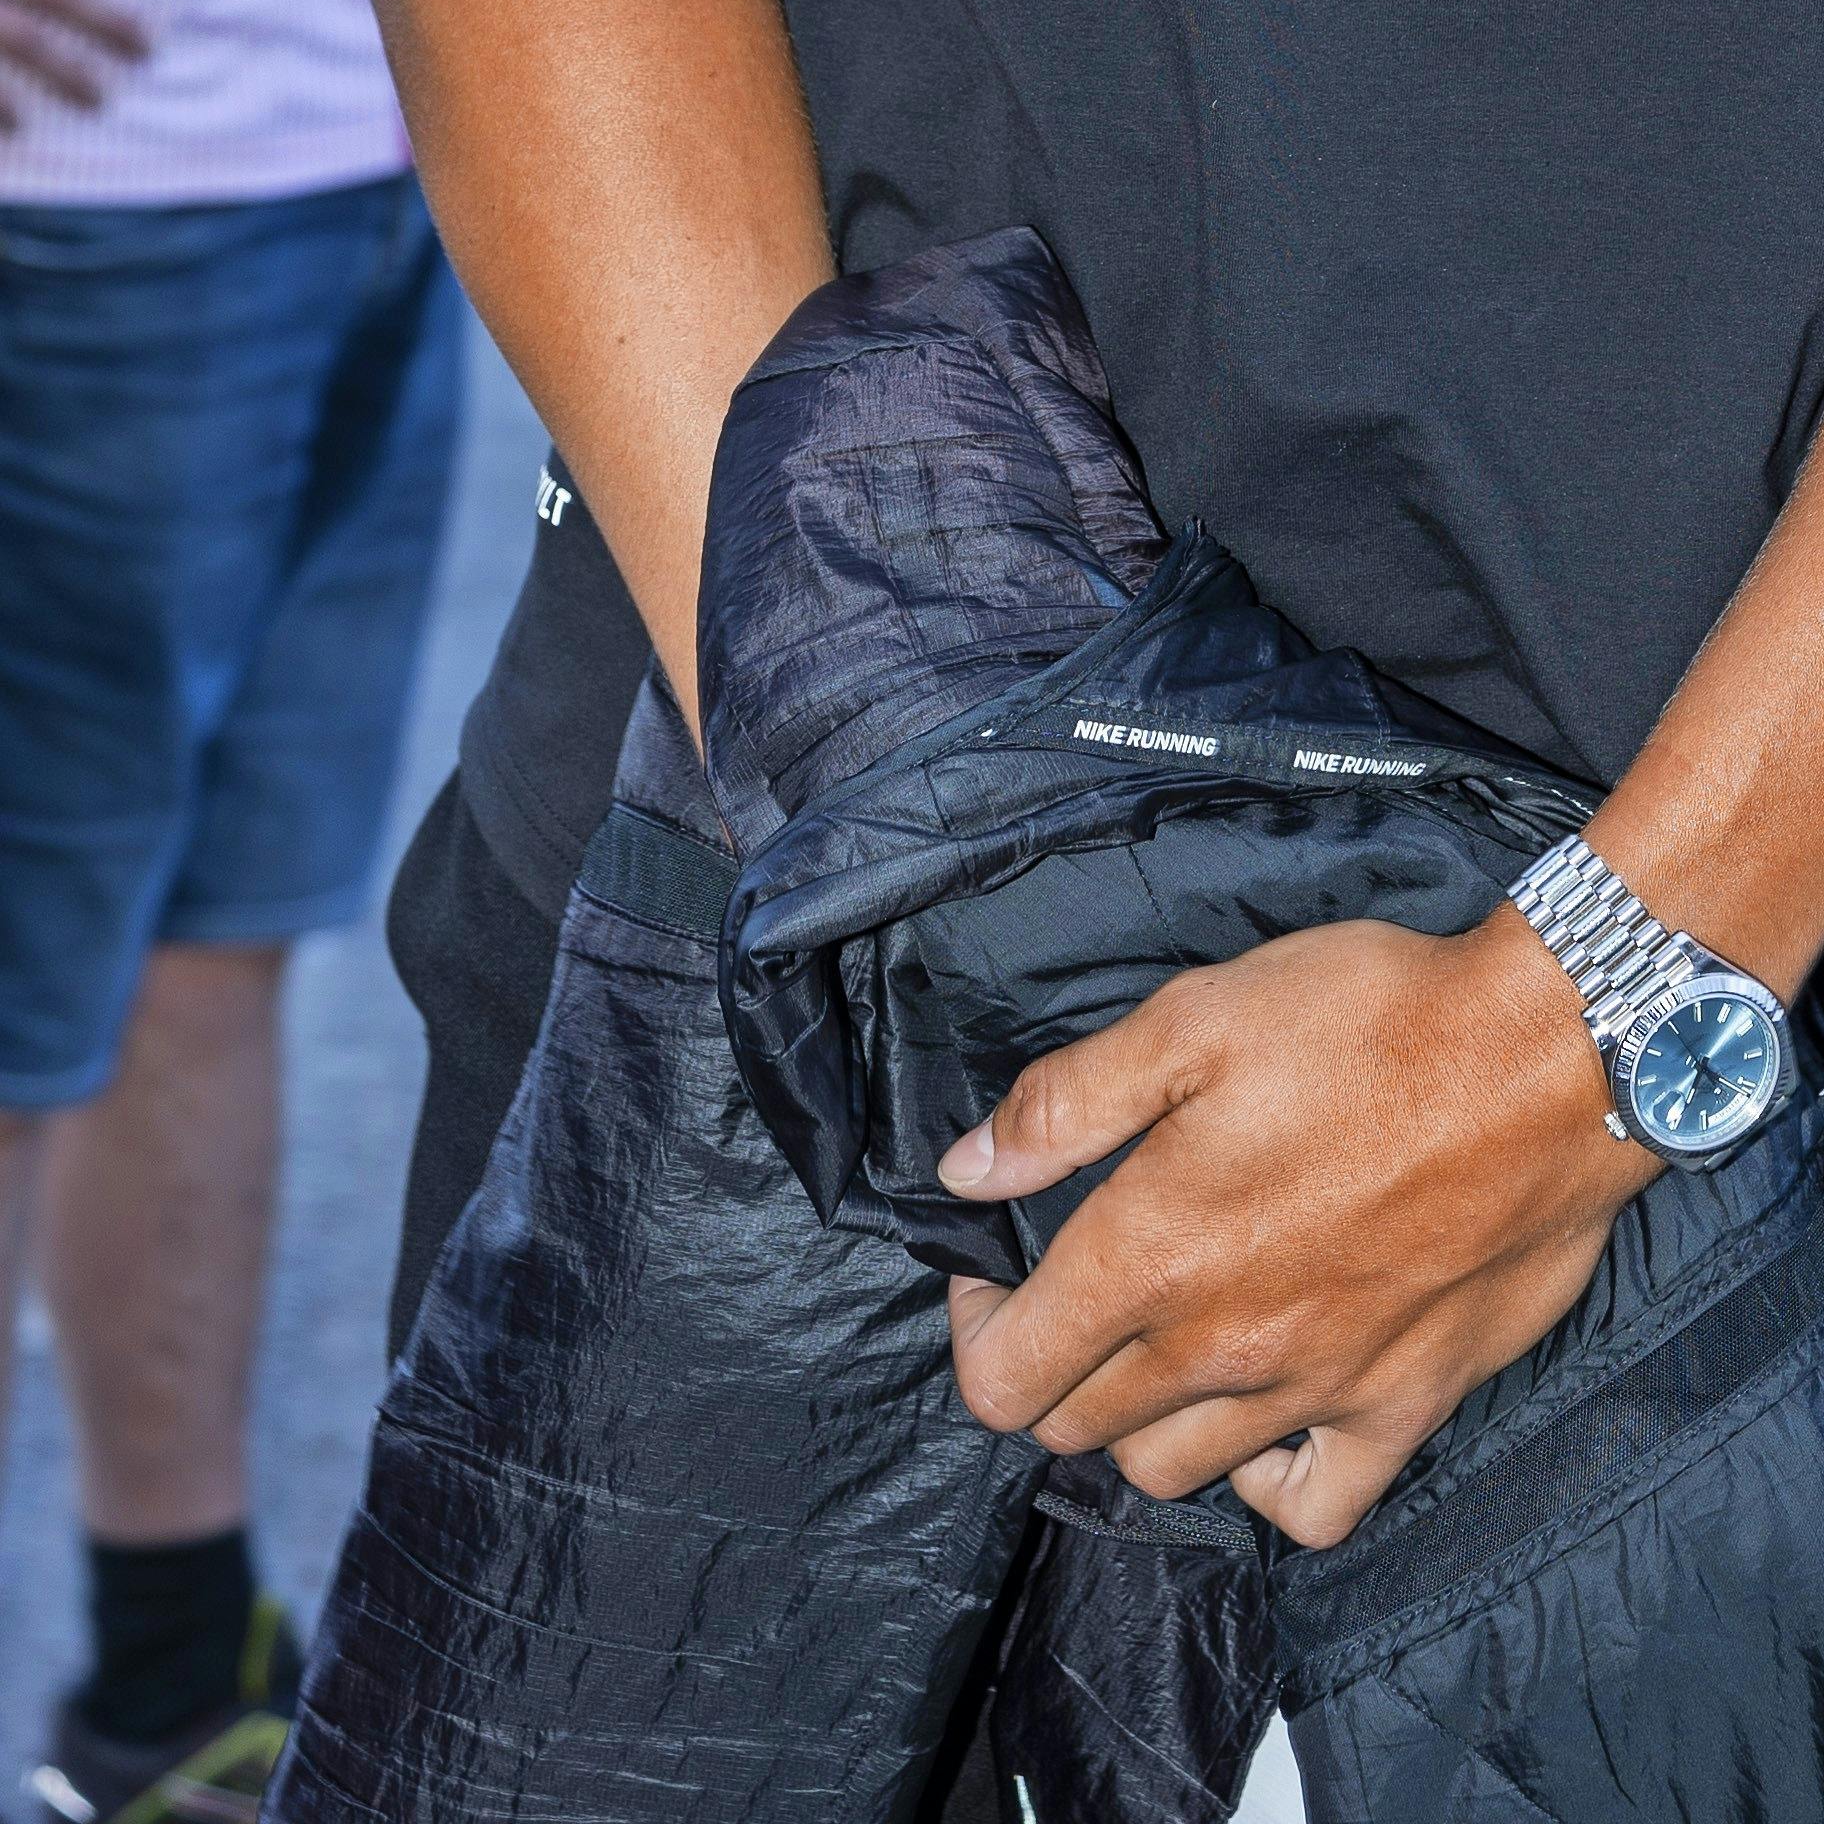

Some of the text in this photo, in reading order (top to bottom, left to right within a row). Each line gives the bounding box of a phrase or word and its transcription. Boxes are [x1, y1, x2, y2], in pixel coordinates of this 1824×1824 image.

[1073, 719, 1218, 757] NIKE RUNNING
[1293, 749, 1427, 777] NIKE RUNNING
